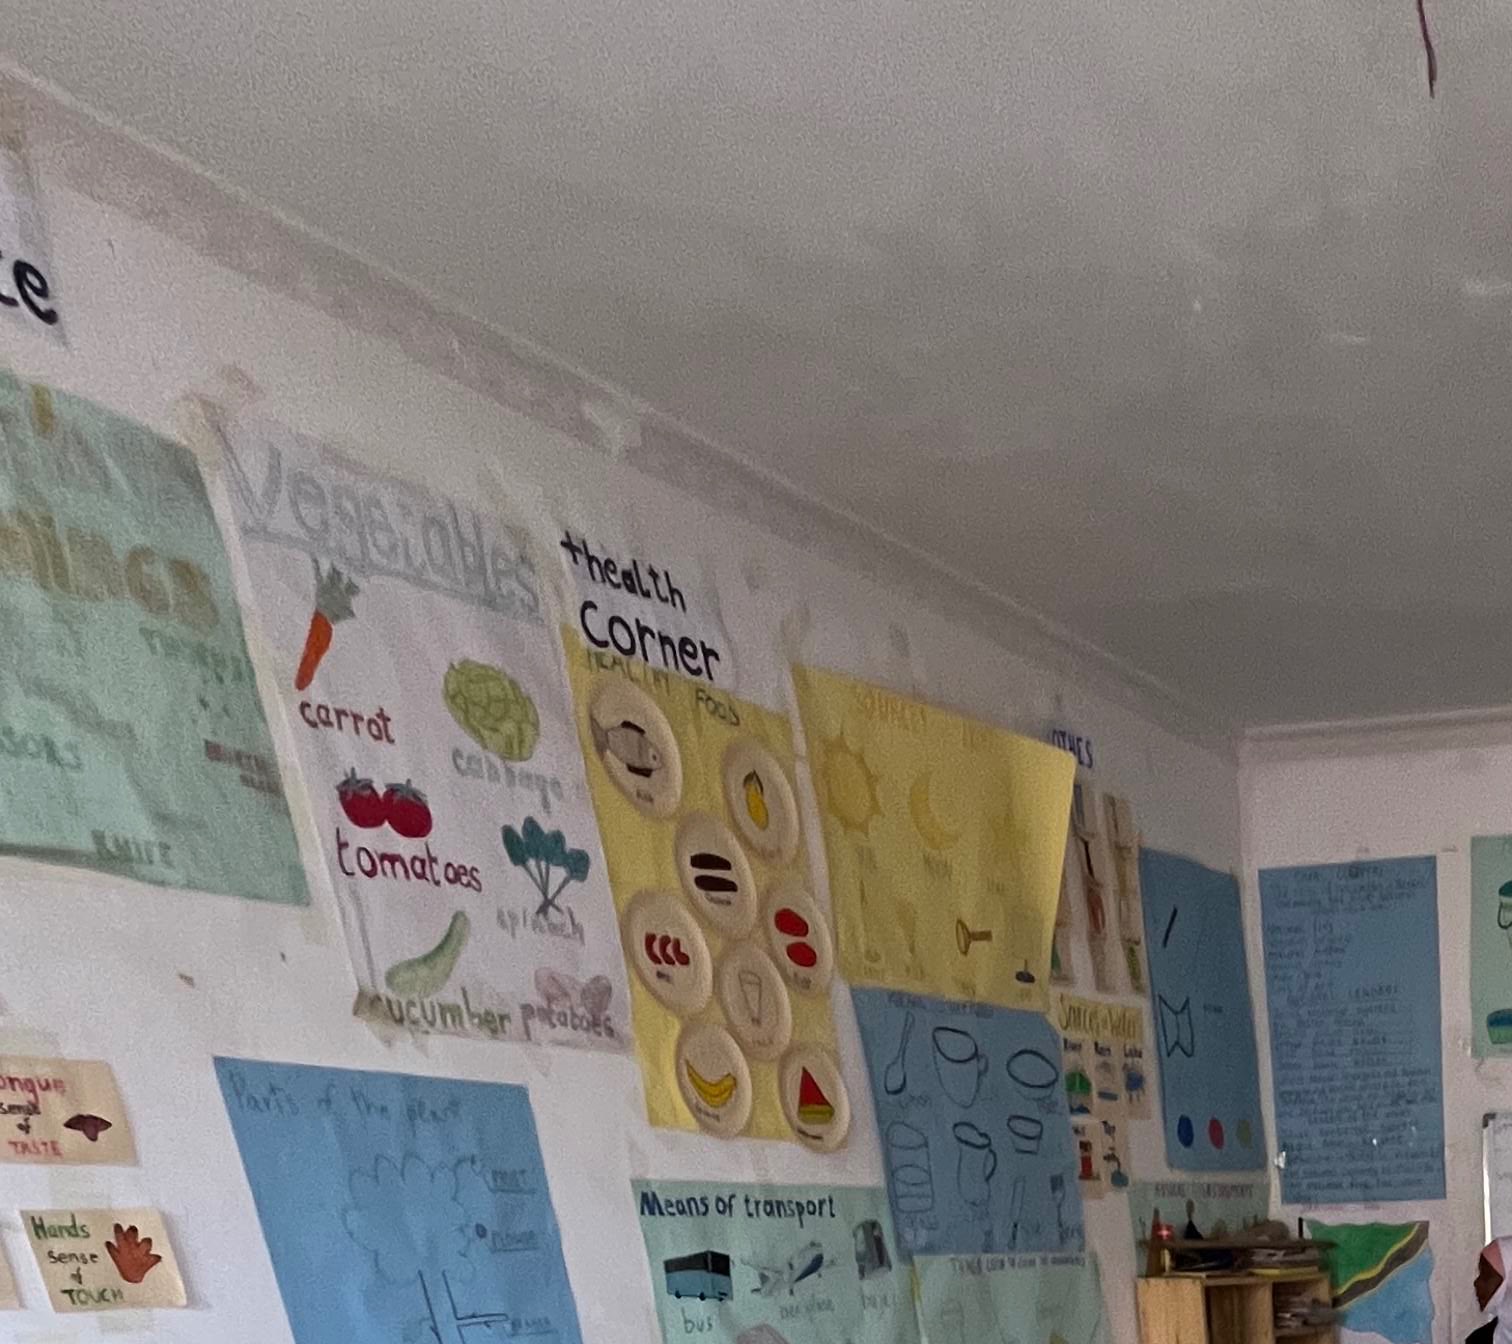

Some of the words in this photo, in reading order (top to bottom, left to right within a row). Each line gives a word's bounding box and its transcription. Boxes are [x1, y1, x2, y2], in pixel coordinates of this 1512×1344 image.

[0, 250, 61, 326] e
[579, 600, 721, 682] Corner
[300, 700, 397, 745] carrot
[335, 826, 483, 896] tomatoes
[380, 985, 511, 1037] ucumber
[640, 1189, 710, 1219] Means
[715, 1192, 736, 1218] of
[744, 1193, 836, 1230] transport
[682, 1307, 715, 1335] bus
